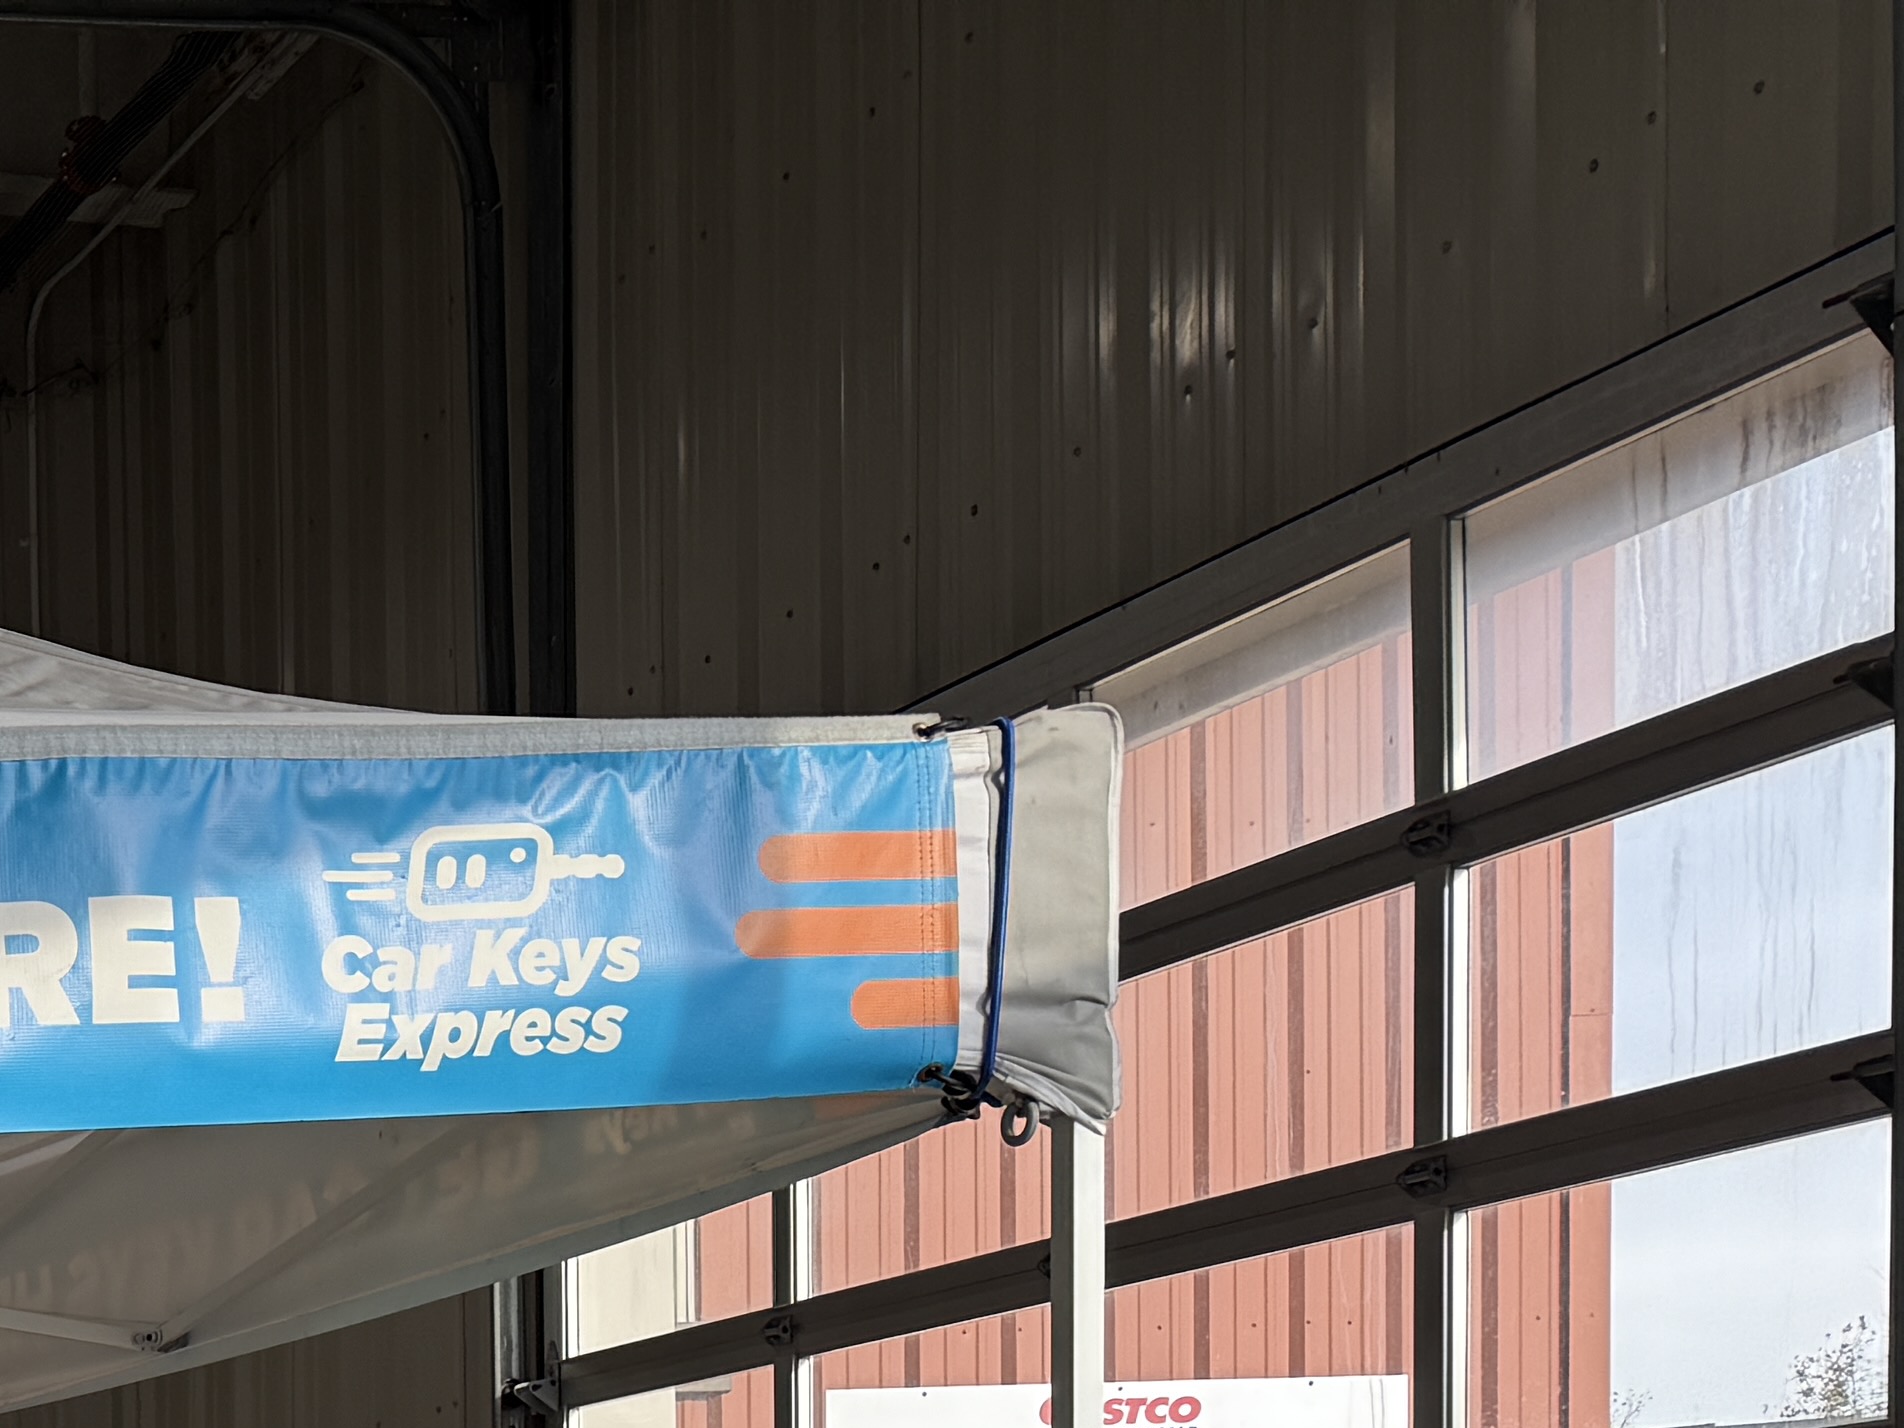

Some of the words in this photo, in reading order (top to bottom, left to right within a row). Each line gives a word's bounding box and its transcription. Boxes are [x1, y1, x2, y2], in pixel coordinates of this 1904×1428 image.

[321, 934, 453, 994] Car
[467, 927, 642, 996] Keys
[334, 1003, 628, 1072] Express
